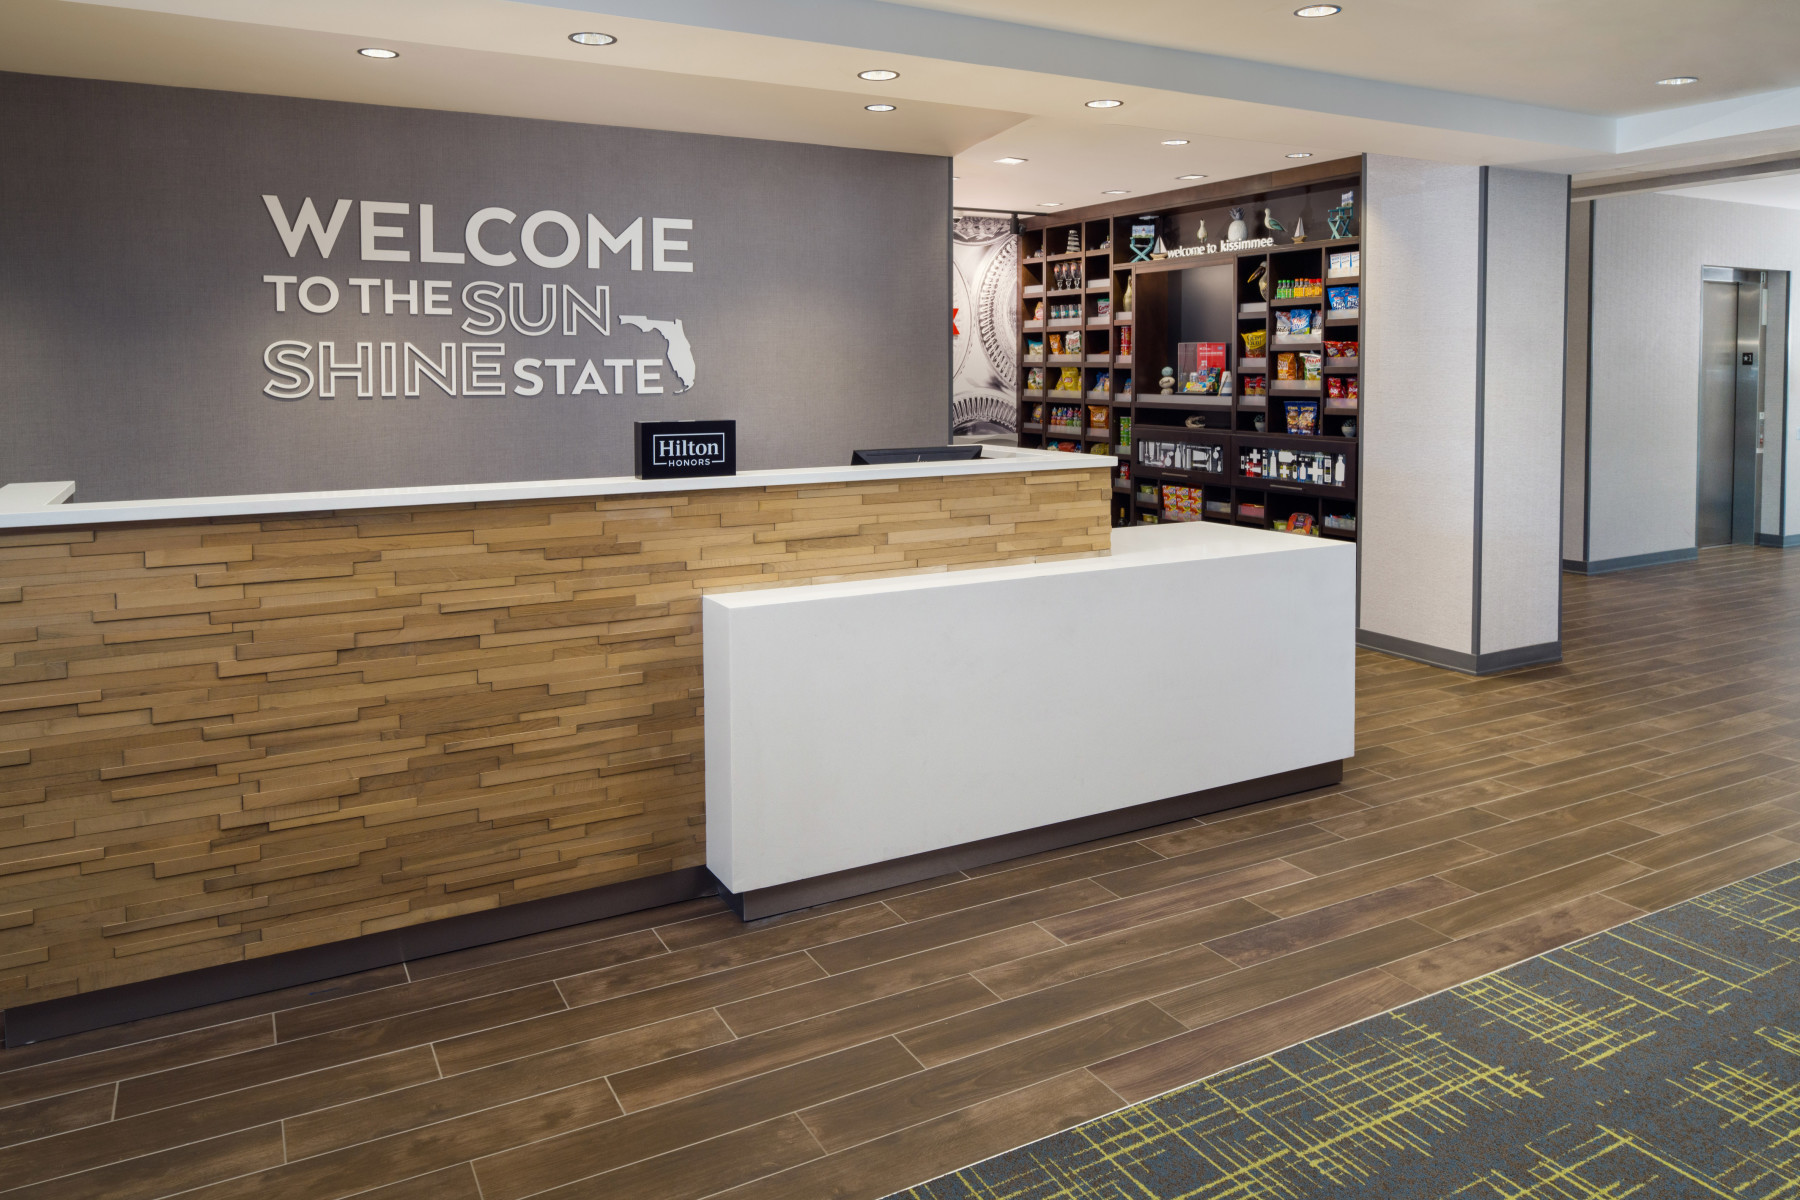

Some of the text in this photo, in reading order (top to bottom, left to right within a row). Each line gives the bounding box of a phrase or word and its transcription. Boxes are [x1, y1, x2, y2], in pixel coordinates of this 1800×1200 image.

[262, 195, 694, 273] WELCOME
[1167, 237, 1274, 258] welcome to kissimmee
[263, 275, 611, 337] TO THE SUN
[263, 340, 664, 399] SHINE STATE
[659, 440, 719, 457] Hilton
[668, 459, 711, 467] HONORS
